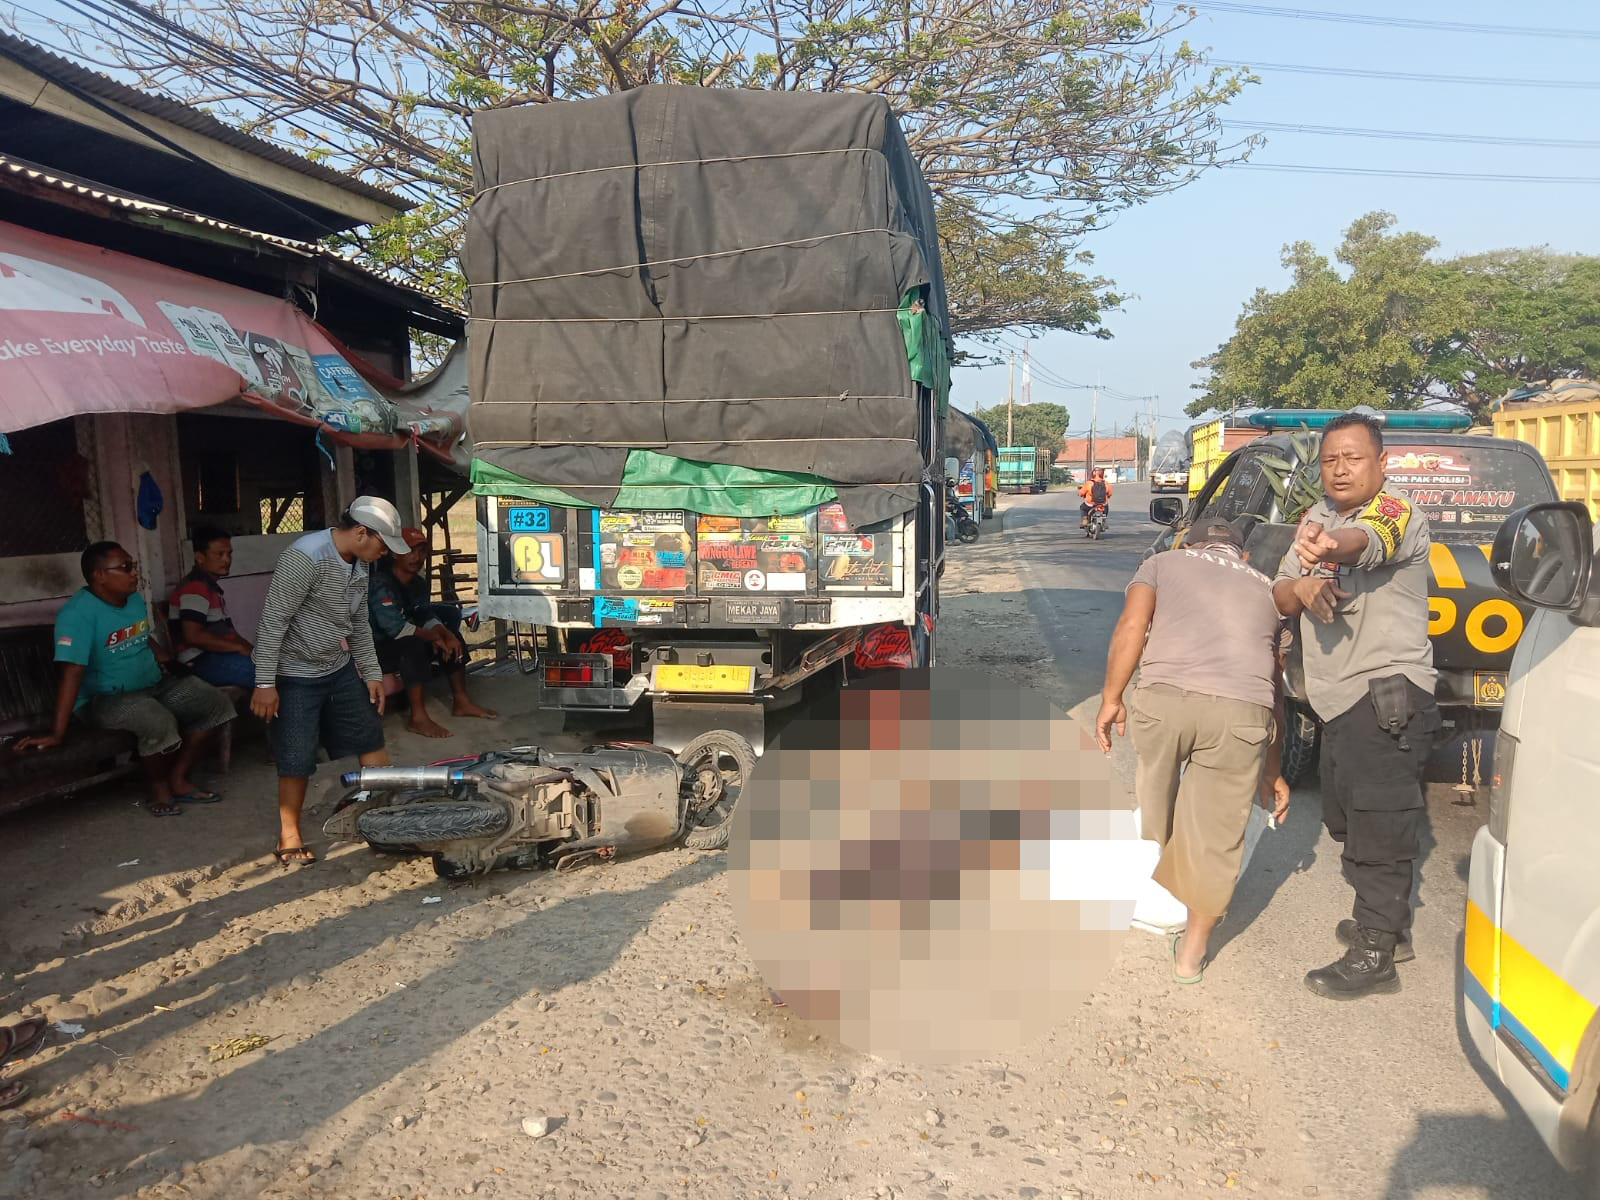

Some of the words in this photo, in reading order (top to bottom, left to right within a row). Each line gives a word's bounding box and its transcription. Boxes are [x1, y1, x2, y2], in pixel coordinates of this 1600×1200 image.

[40, 335, 137, 357] Everyday
[136, 336, 187, 355] Taste
[1411, 475, 1431, 483] PAK
[1433, 476, 1465, 484] POLISI
[1411, 489, 1516, 508] INDRAMAYU
[513, 512, 546, 527] #32
[513, 536, 561, 578] BL
[728, 605, 757, 615] MEKAR
[759, 605, 778, 615] JAYA
